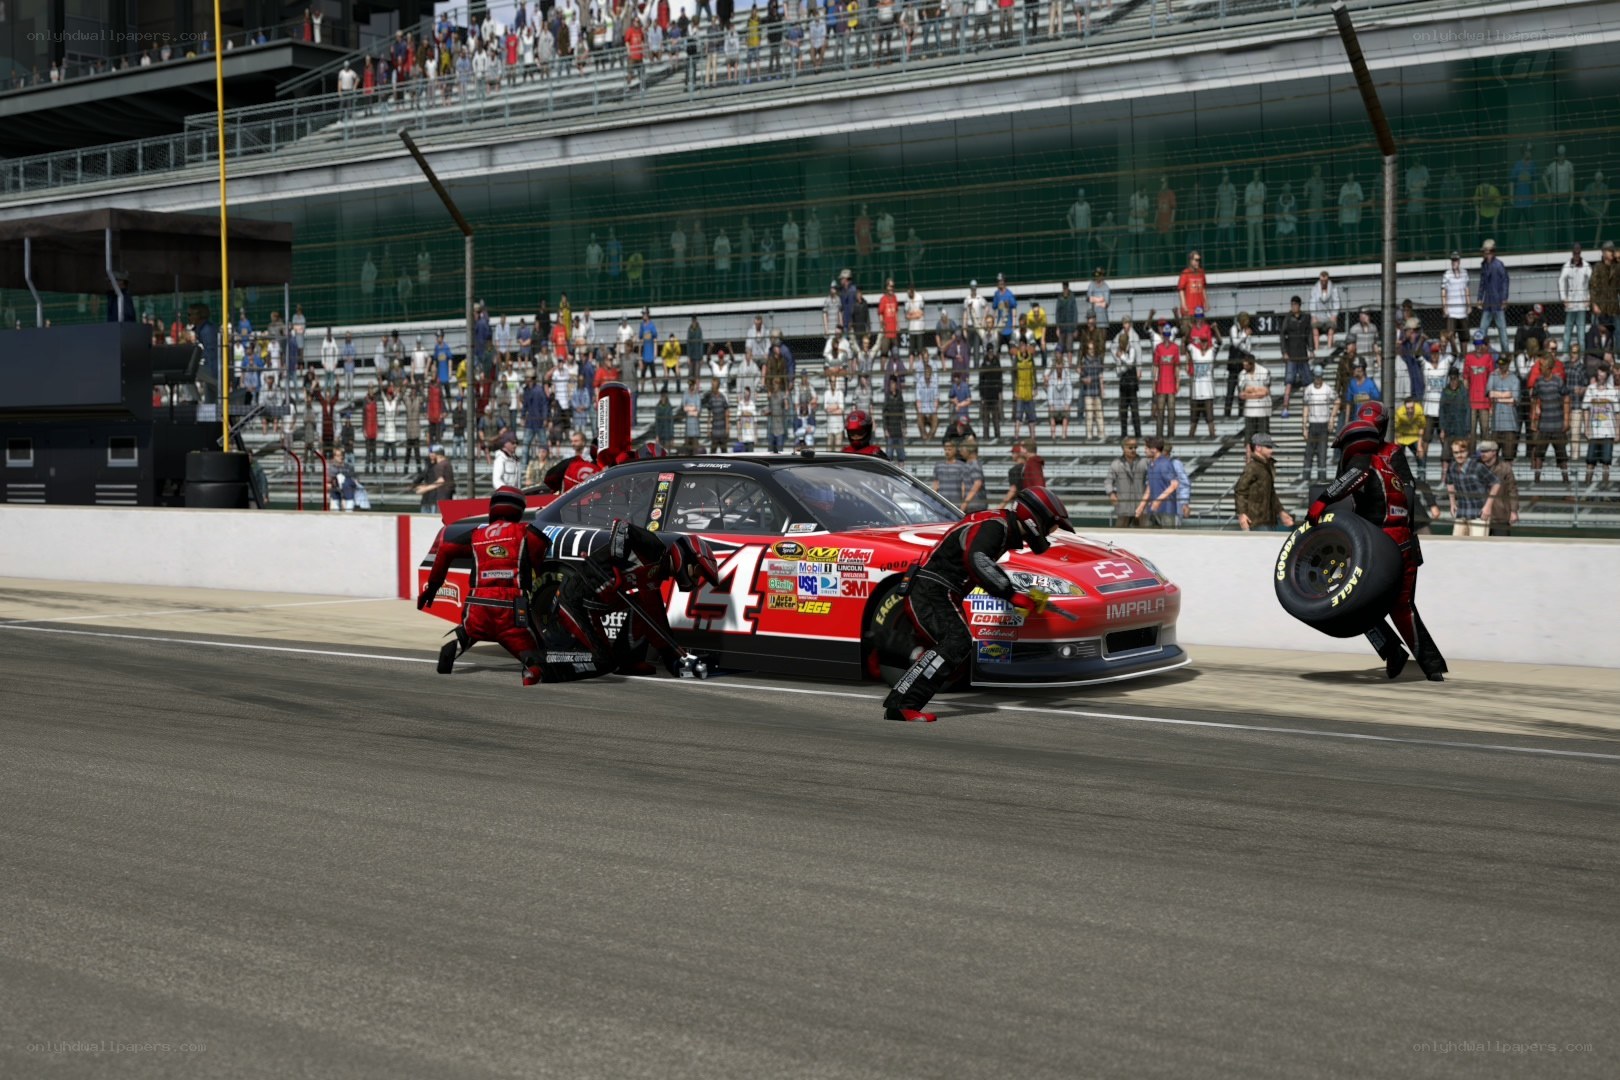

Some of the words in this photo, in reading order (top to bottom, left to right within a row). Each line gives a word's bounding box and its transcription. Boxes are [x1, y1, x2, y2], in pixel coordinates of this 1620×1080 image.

[1258, 316, 1273, 332] 31
[1276, 512, 1335, 581] GOODYER
[840, 548, 872, 562] Holley
[799, 563, 822, 572] Mobil
[667, 544, 767, 634] 14
[798, 575, 817, 595] USG
[841, 580, 867, 597] 3M
[1031, 575, 1049, 588] 14
[1331, 565, 1363, 607] EAGLE
[797, 601, 832, 614] JEGS
[972, 600, 1013, 611] MAHL
[1106, 598, 1165, 620] IMPALA
[974, 615, 1011, 623] COMP
